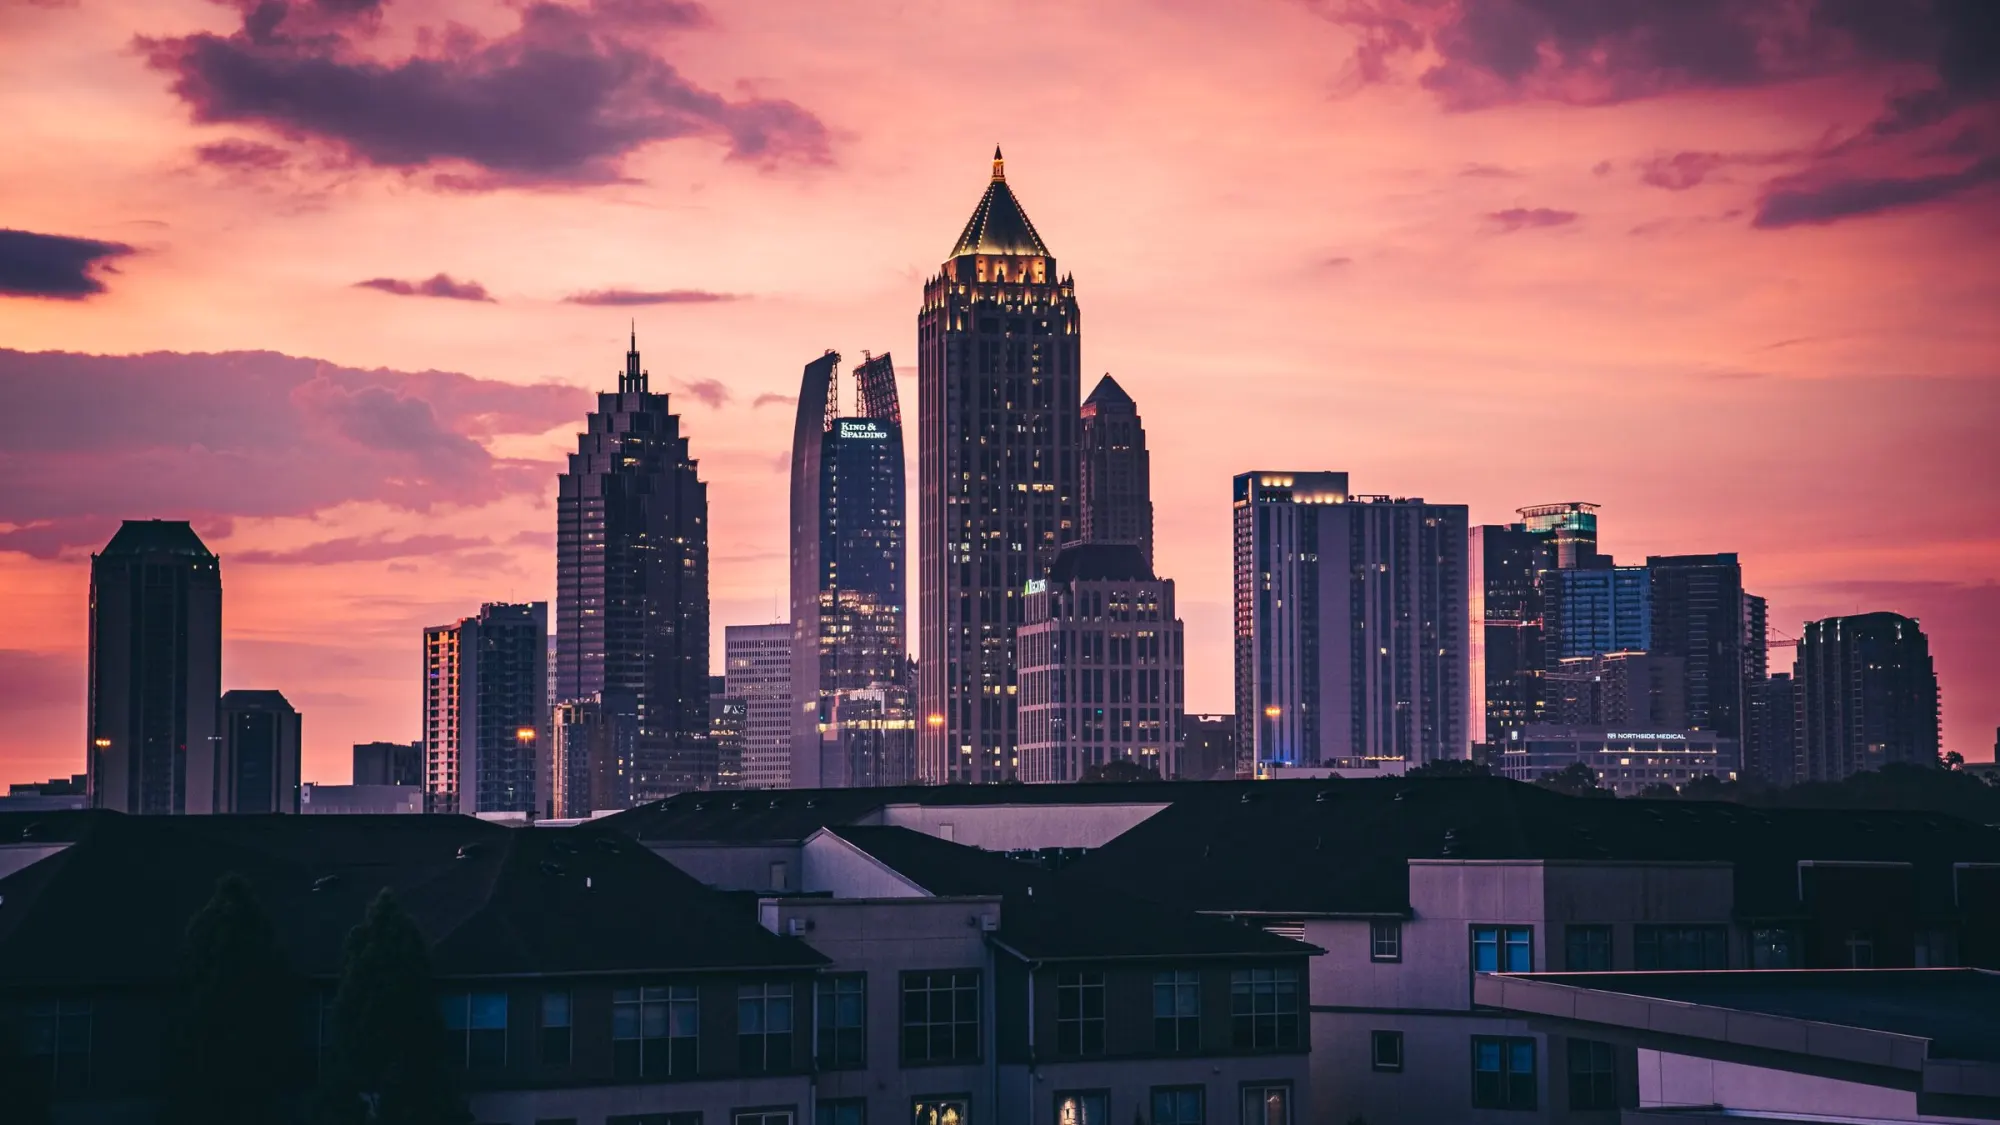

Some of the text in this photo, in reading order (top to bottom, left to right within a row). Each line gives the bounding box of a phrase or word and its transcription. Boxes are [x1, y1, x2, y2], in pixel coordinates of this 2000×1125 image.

[841, 422, 876, 431] KING &
[841, 430, 887, 438] SPALDING
